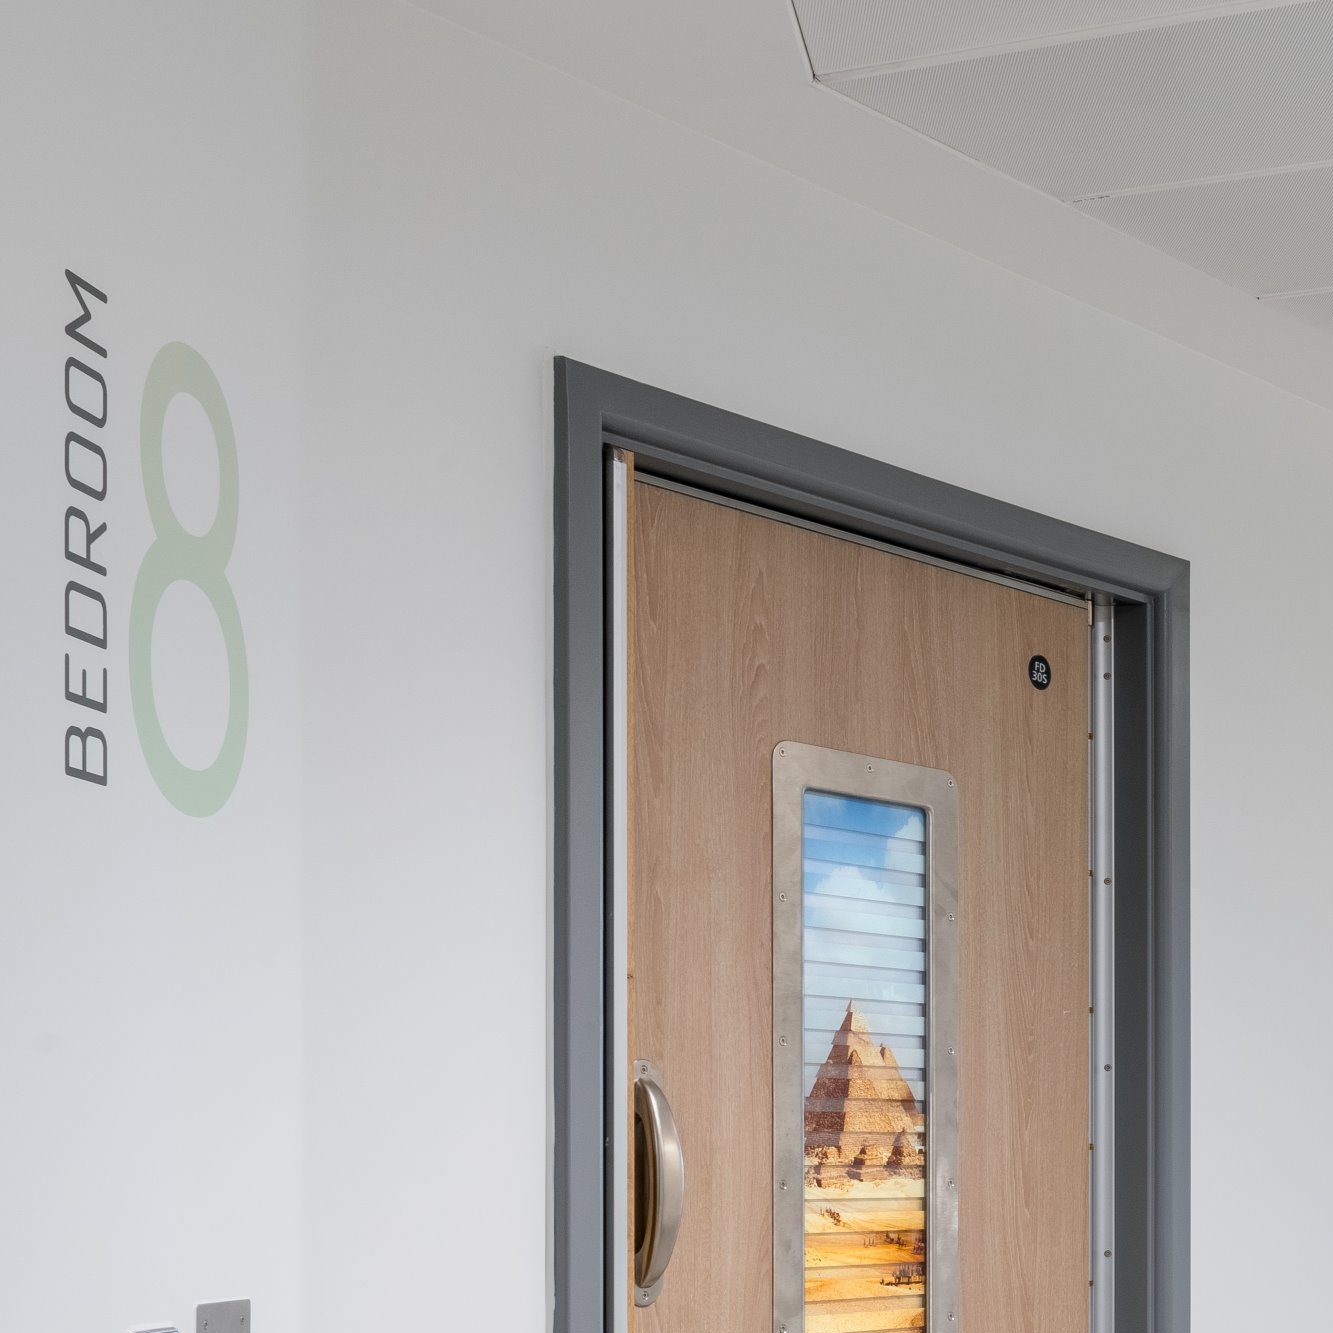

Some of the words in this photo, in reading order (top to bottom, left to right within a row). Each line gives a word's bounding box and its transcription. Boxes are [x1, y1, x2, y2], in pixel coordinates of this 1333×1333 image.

[64, 268, 108, 787] BEDROOM
[128, 341, 250, 818] 8
[1032, 670, 1048, 684] 30S
[1035, 661, 1046, 672] FD
